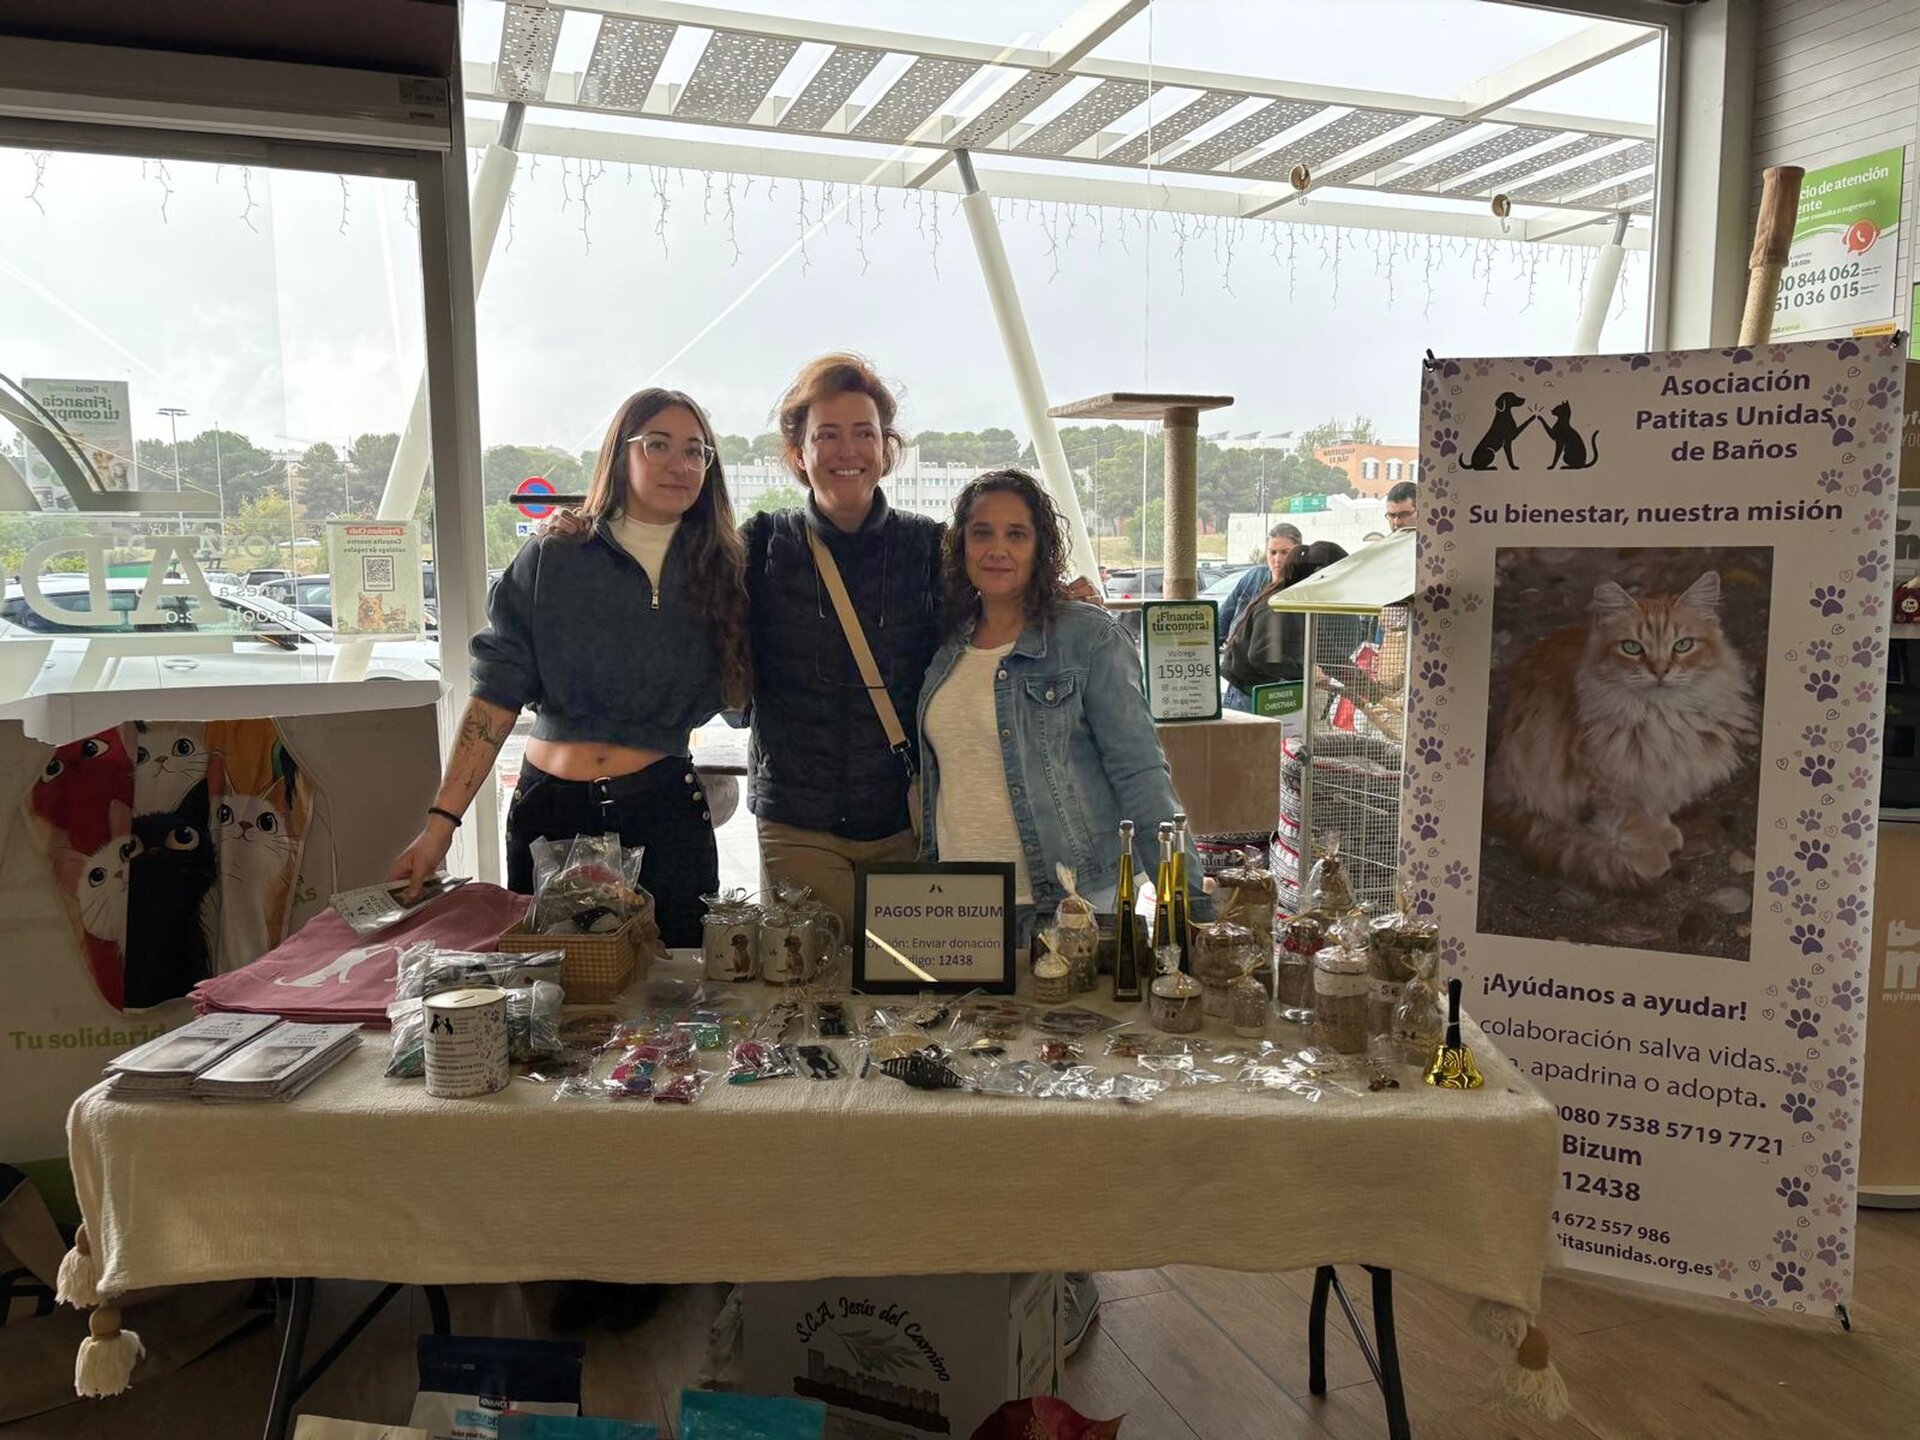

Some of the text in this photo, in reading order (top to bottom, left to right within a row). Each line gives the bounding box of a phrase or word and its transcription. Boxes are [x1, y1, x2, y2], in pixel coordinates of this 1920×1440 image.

[1818, 180, 1834, 195] de
[1834, 166, 1889, 191] atención
[1797, 198, 1823, 215] ente
[1798, 269, 1826, 289] 844
[1829, 262, 1860, 282] 062
[1774, 294, 1789, 312] 51
[1793, 288, 1825, 311] 036
[1830, 280, 1860, 301] 015
[1661, 370, 1811, 397] Asociación
[1636, 404, 1833, 431] Patitas Unidas
[1671, 439, 1798, 462] de Baños
[1469, 499, 1843, 528] Su bienestar, nuestra misión
[1152, 620, 1210, 633] tu compra!
[1156, 610, 1205, 624] ¡Financia
[1157, 663, 1212, 681] 159,99€
[874, 905, 1004, 918] PAGOS POR BIZUM
[912, 937, 946, 949] Enviar
[949, 937, 1000, 949] donación
[938, 954, 974, 966] 12438
[1482, 974, 1748, 1022] ¡Ayúdanos a ayudar!
[10, 1030, 43, 1051] Tu
[1480, 1016, 1783, 1074] colaboración salva vidas.
[1531, 1058, 1637, 1092] apadrina
[1644, 1075, 1660, 1093] o
[1666, 1077, 1767, 1110] adopta.
[1605, 1112, 1661, 1136] 7538
[1665, 1121, 1722, 1145] 5719
[1728, 1130, 1784, 1157] 7721
[1562, 1133, 1643, 1168] Bizum
[1562, 1171, 1642, 1203] 12438
[1564, 1211, 1597, 1231] 672
[1599, 1218, 1633, 1238] 557
[1637, 1224, 1671, 1245] 986
[838, 1296, 876, 1320] Jesús
[878, 1302, 909, 1328] del
[903, 1322, 951, 1383] Camino
